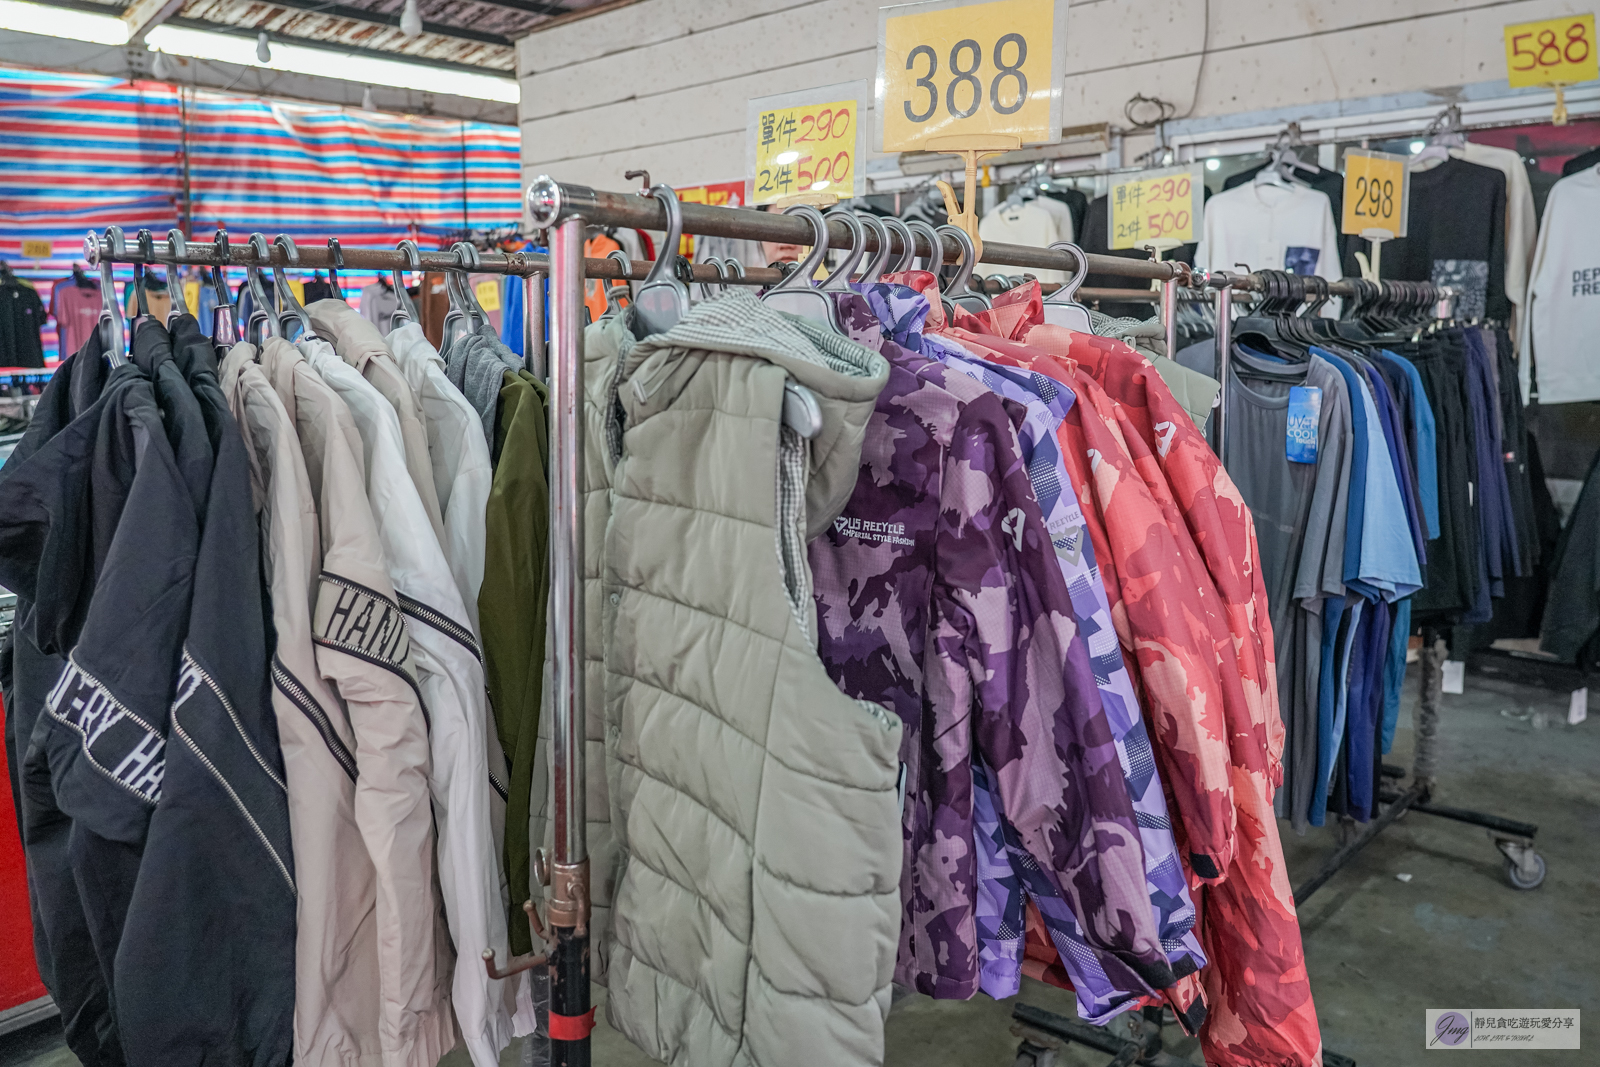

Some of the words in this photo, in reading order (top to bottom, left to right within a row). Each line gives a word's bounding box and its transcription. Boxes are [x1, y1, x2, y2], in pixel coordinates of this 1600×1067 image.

[1512, 23, 1589, 71] 588
[903, 32, 1028, 123] 388
[761, 112, 797, 154] 單件
[794, 108, 850, 144] 290
[758, 163, 793, 195] 2件
[797, 151, 850, 192] 500
[1146, 178, 1191, 204] 290
[1354, 176, 1394, 219] 298
[1117, 215, 1142, 241] 2件
[1148, 210, 1189, 239] 500
[1572, 267, 1600, 283] DEP
[1572, 281, 1600, 297] FRE
[1288, 414, 1306, 427] UV
[1288, 429, 1315, 440] COOL
[842, 528, 872, 540] IMPERIAL
[872, 533, 892, 543] STYLE
[892, 536, 915, 547] FASHION
